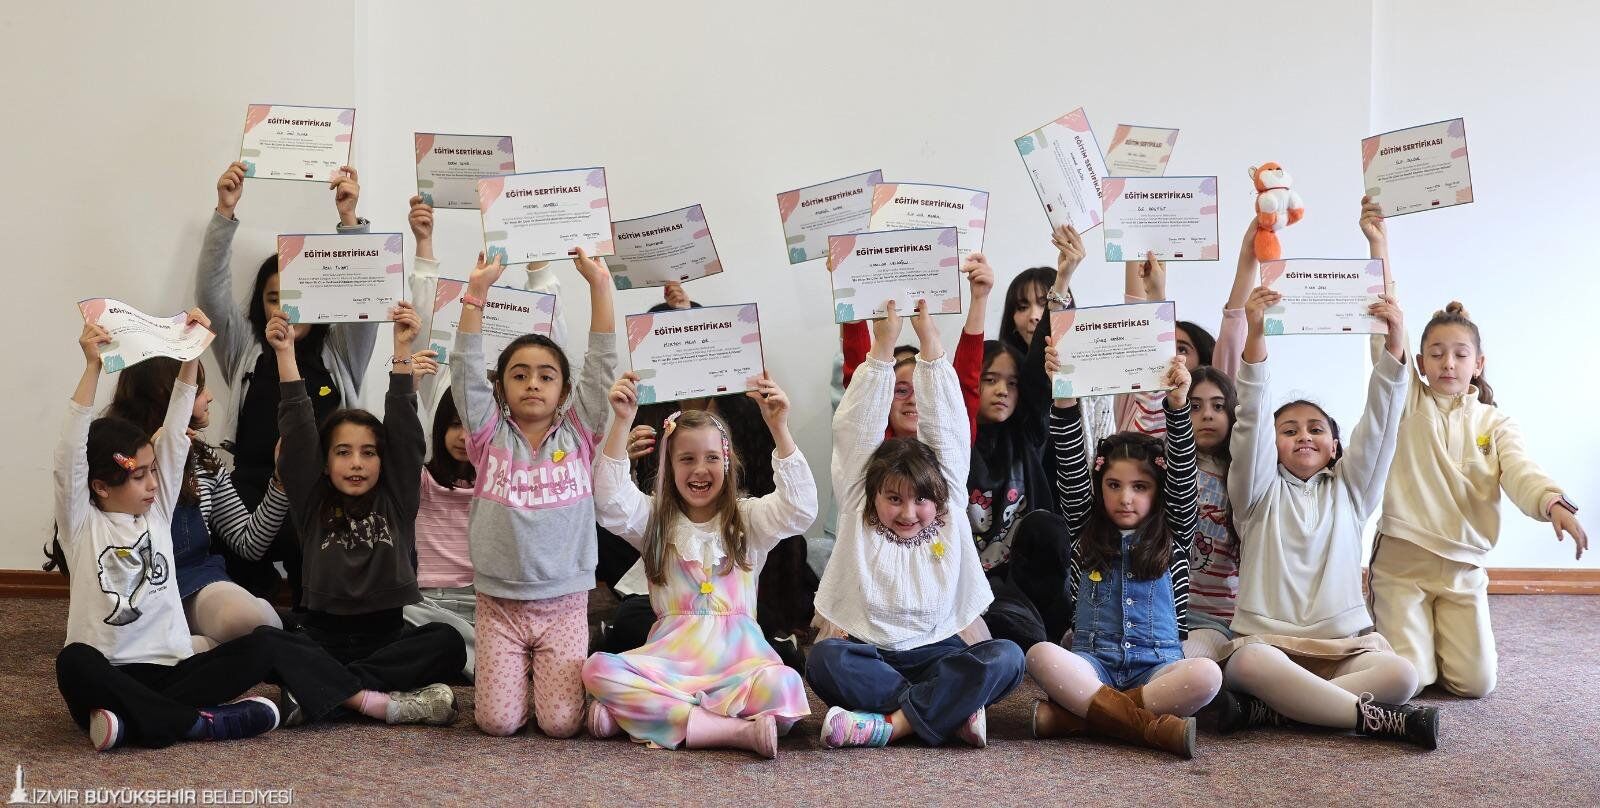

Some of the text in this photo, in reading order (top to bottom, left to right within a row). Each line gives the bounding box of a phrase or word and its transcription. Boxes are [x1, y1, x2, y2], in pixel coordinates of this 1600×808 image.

[505, 185, 581, 198] EĞİTİM SERTİFİKASI
[1124, 190, 1194, 200] EĞİTİM SERTİFİKASI
[894, 196, 964, 210] EĞİTİM SERTİFİKASI
[304, 248, 379, 258] EĞİTİM SERTİFİKASI
[856, 244, 932, 256] EĞİTİM SERTİFİKASI
[1286, 271, 1360, 279] EĞİTİM SERTİFİKASI
[486, 301, 530, 314] SERTİFİKASI
[654, 321, 732, 336] EĞİTİM SERTİFİKASI
[1075, 318, 1150, 332] EĞİTİM SERTİFİKASI
